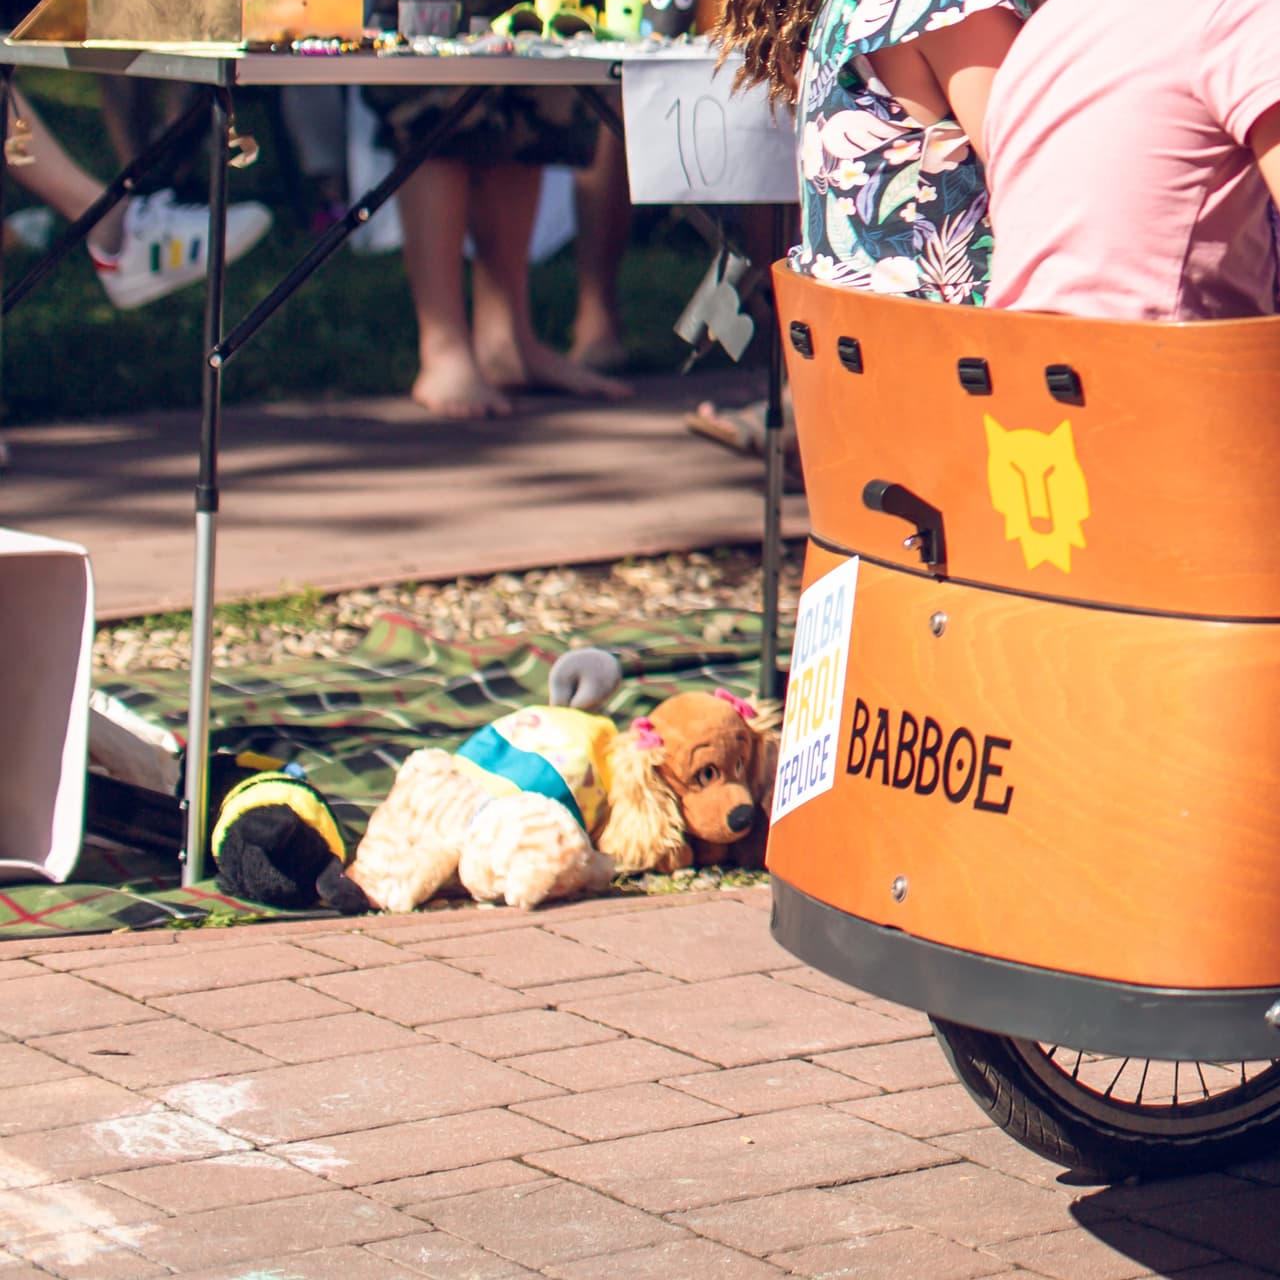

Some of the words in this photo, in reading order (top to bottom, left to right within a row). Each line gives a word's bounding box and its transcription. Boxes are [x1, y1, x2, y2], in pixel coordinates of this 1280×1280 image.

[782, 648, 841, 753] PRO!
[775, 734, 831, 811] TEPLICE
[846, 697, 1014, 815] BABBOE
